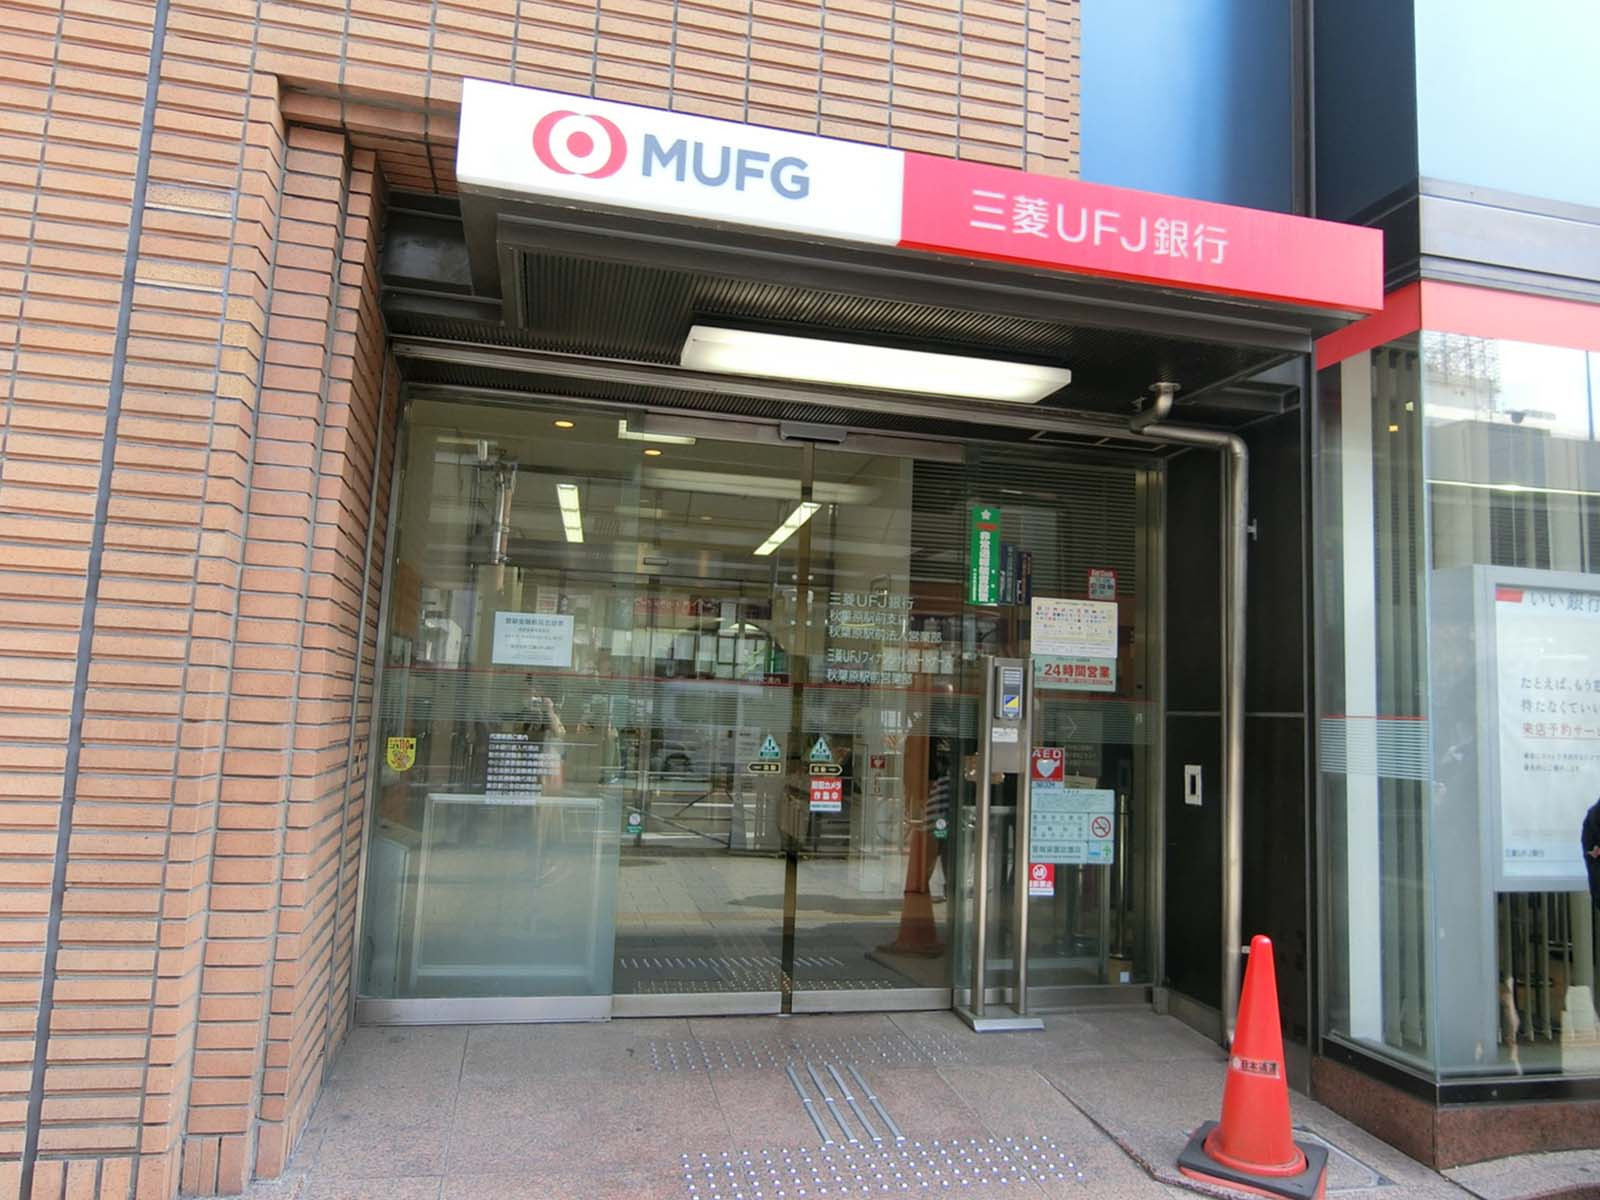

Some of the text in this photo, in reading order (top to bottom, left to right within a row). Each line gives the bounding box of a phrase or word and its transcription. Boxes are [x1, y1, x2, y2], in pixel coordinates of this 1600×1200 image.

[642, 133, 810, 200] MUFG
[969, 189, 1229, 265] 三菱UFJ銀行
[829, 591, 914, 610] 三菱UFJ銀行
[1043, 663, 1111, 679] 24時間営業
[1521, 721, 1600, 737] 来店予約サー
[1032, 750, 1061, 759] AED
